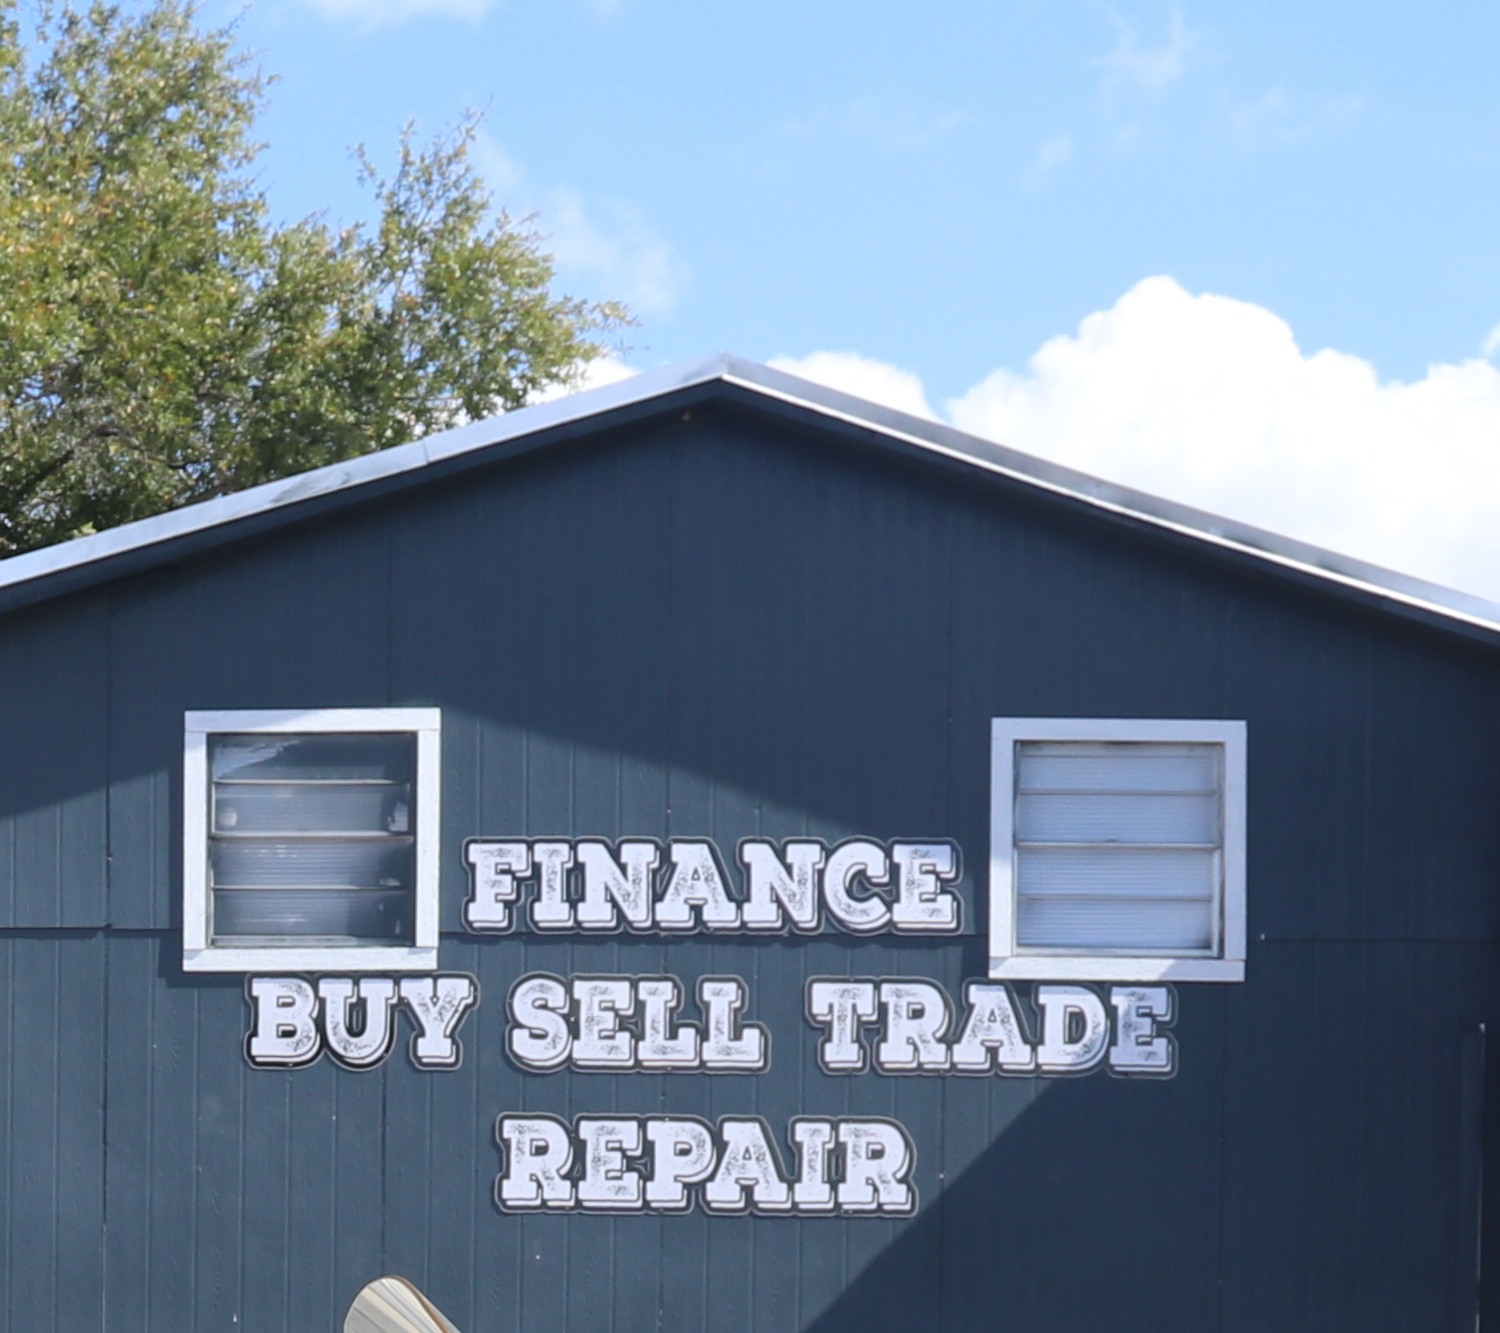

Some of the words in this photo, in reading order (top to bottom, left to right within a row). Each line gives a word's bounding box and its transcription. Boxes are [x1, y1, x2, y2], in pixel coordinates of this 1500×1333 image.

[465, 839, 959, 932] FINANCE
[247, 976, 477, 1067] BUY
[507, 976, 769, 1070] SELL
[808, 980, 1175, 1076] TRADE
[498, 1115, 915, 1213] REPAIR
